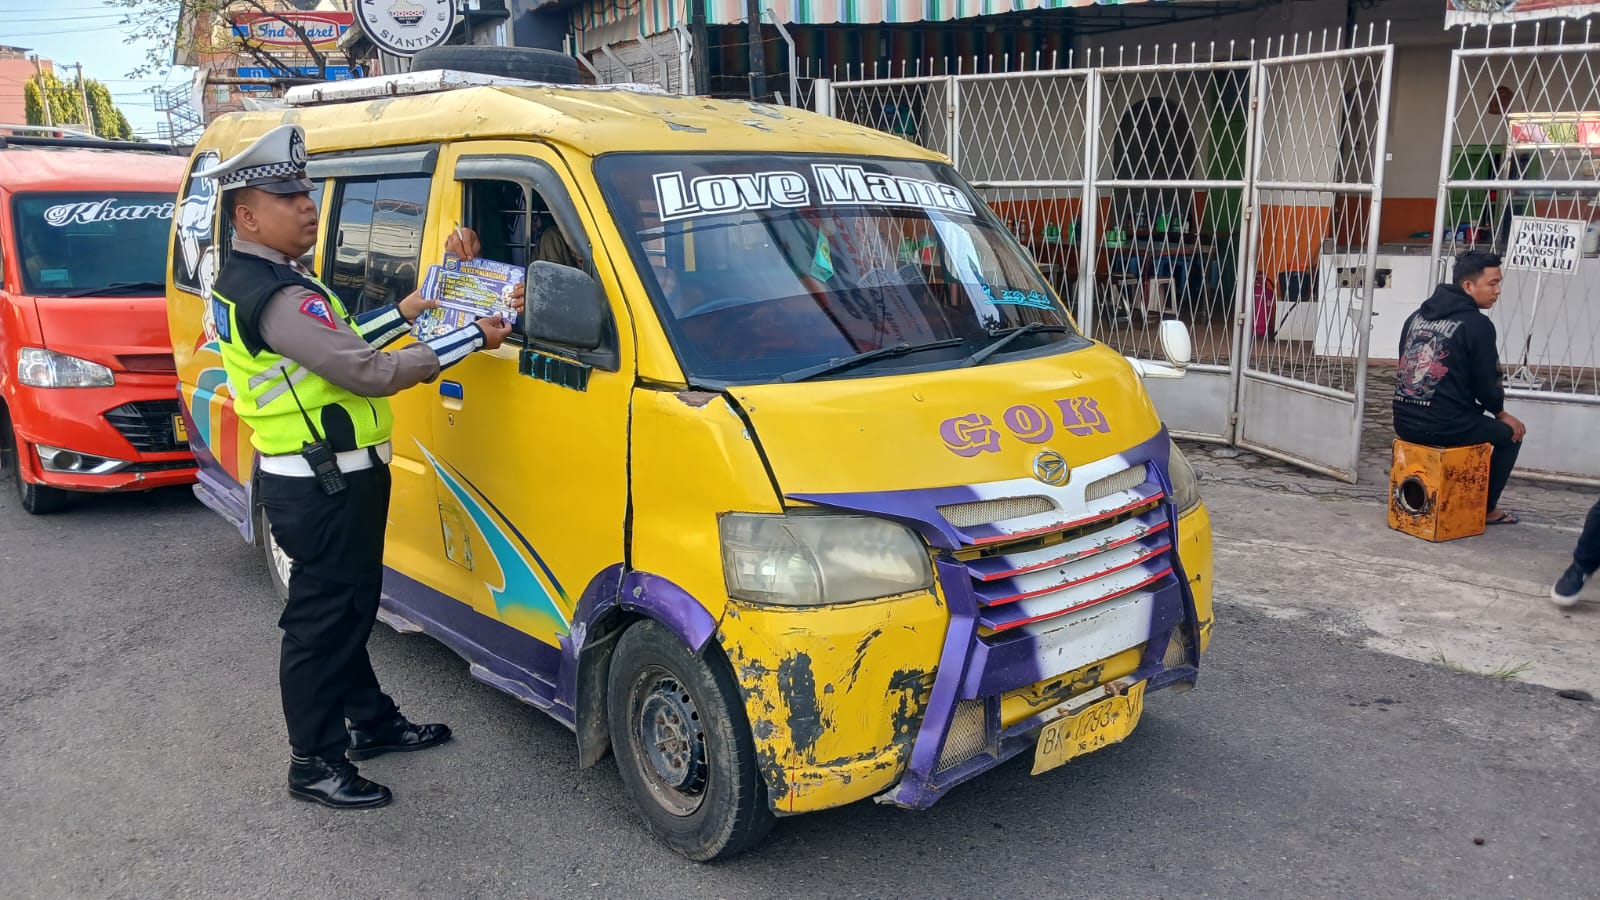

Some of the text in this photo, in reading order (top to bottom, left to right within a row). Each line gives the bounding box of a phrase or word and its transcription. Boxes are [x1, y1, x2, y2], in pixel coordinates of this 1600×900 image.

[380, 29, 441, 48] SIANTAR
[653, 163, 977, 222] Love Mama
[44, 198, 176, 226] Khari
[1523, 222, 1569, 234] KHUSUS
[1516, 231, 1576, 249] PARKIR
[1512, 255, 1572, 270] CINTA ULI
[940, 396, 1112, 458] GOK
[1043, 722, 1067, 755] BK
